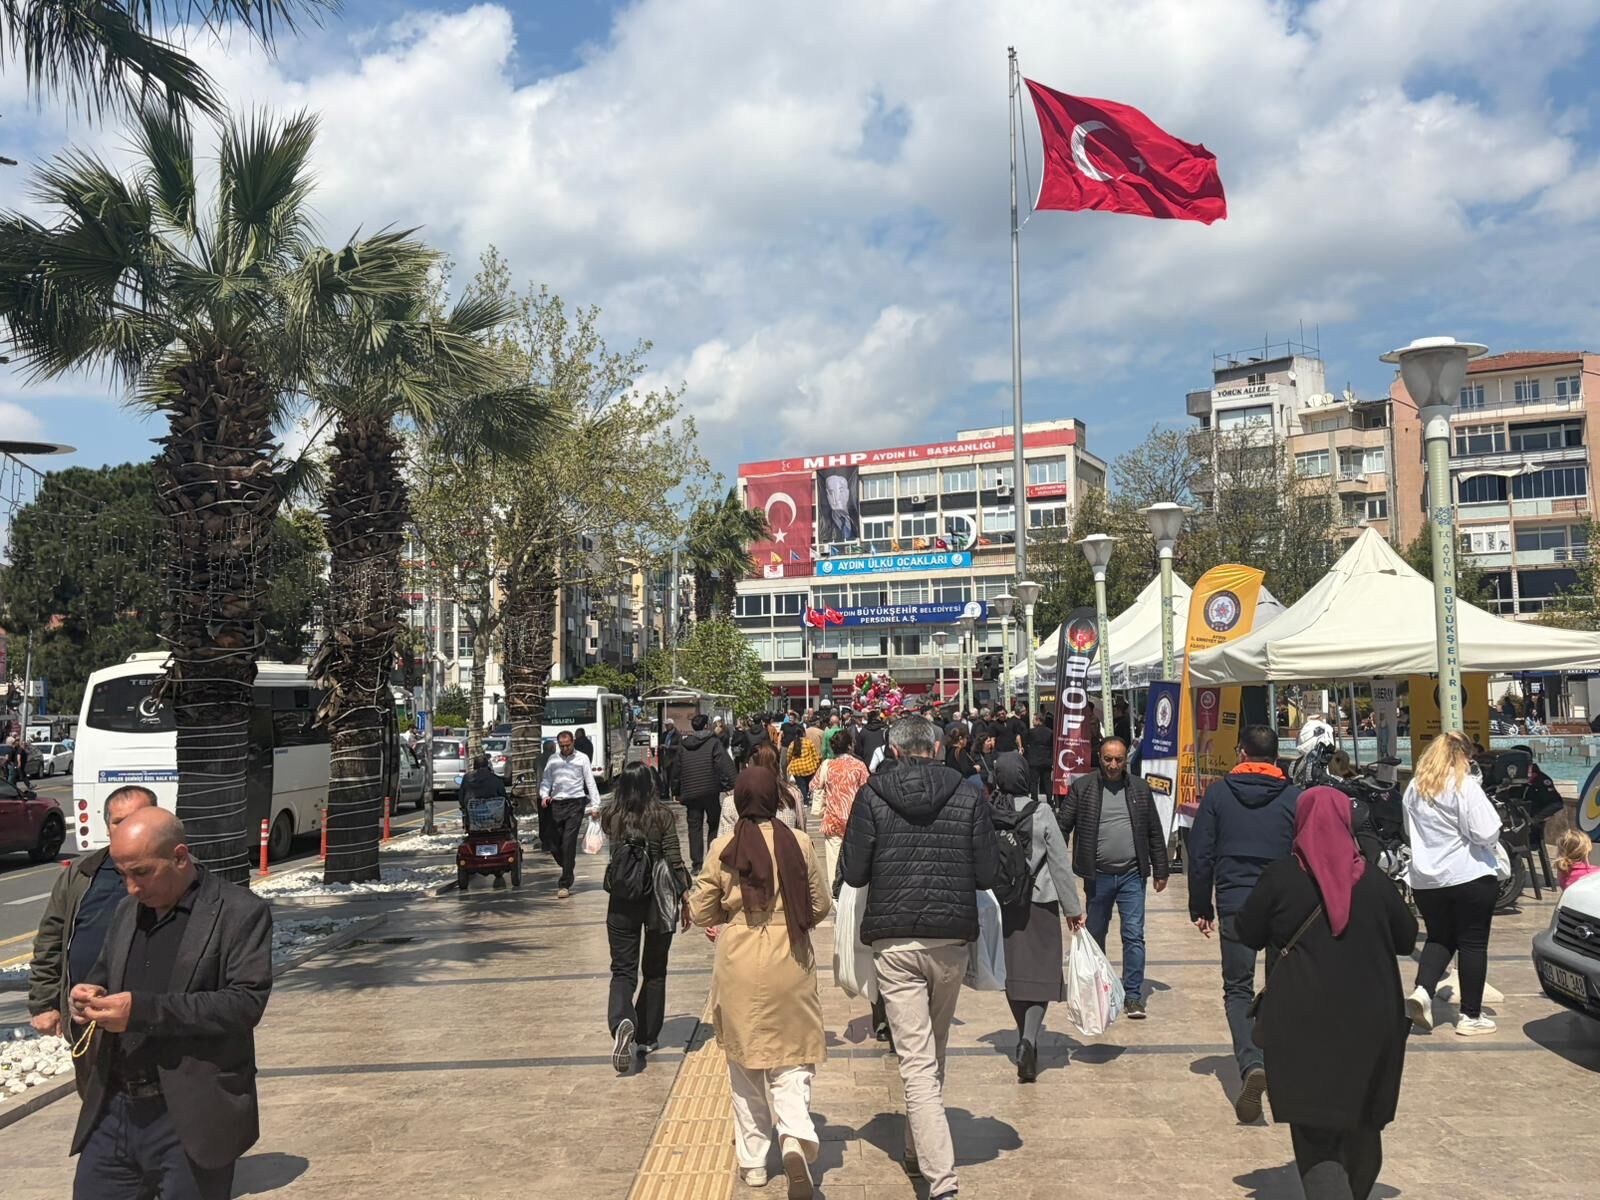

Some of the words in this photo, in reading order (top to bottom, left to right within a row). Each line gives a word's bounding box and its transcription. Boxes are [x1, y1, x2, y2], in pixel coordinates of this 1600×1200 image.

[803, 452, 868, 469] MHP
[872, 451, 905, 461] AYDIN
[909, 447, 919, 457] İL
[927, 441, 996, 456] BAŞKANLIĞI
[837, 560, 865, 571] AYDIN
[868, 557, 894, 569] ÜLKÜ
[897, 555, 948, 567] OCAKLARI
[1442, 544, 1452, 577] AYDIN
[857, 605, 918, 616] BÜYÜKŞEHİR
[920, 605, 962, 614] BELEDİYESİ
[860, 616, 901, 624] PERSONEL
[1444, 586, 1457, 687] BÜYÜKŞEHİR
